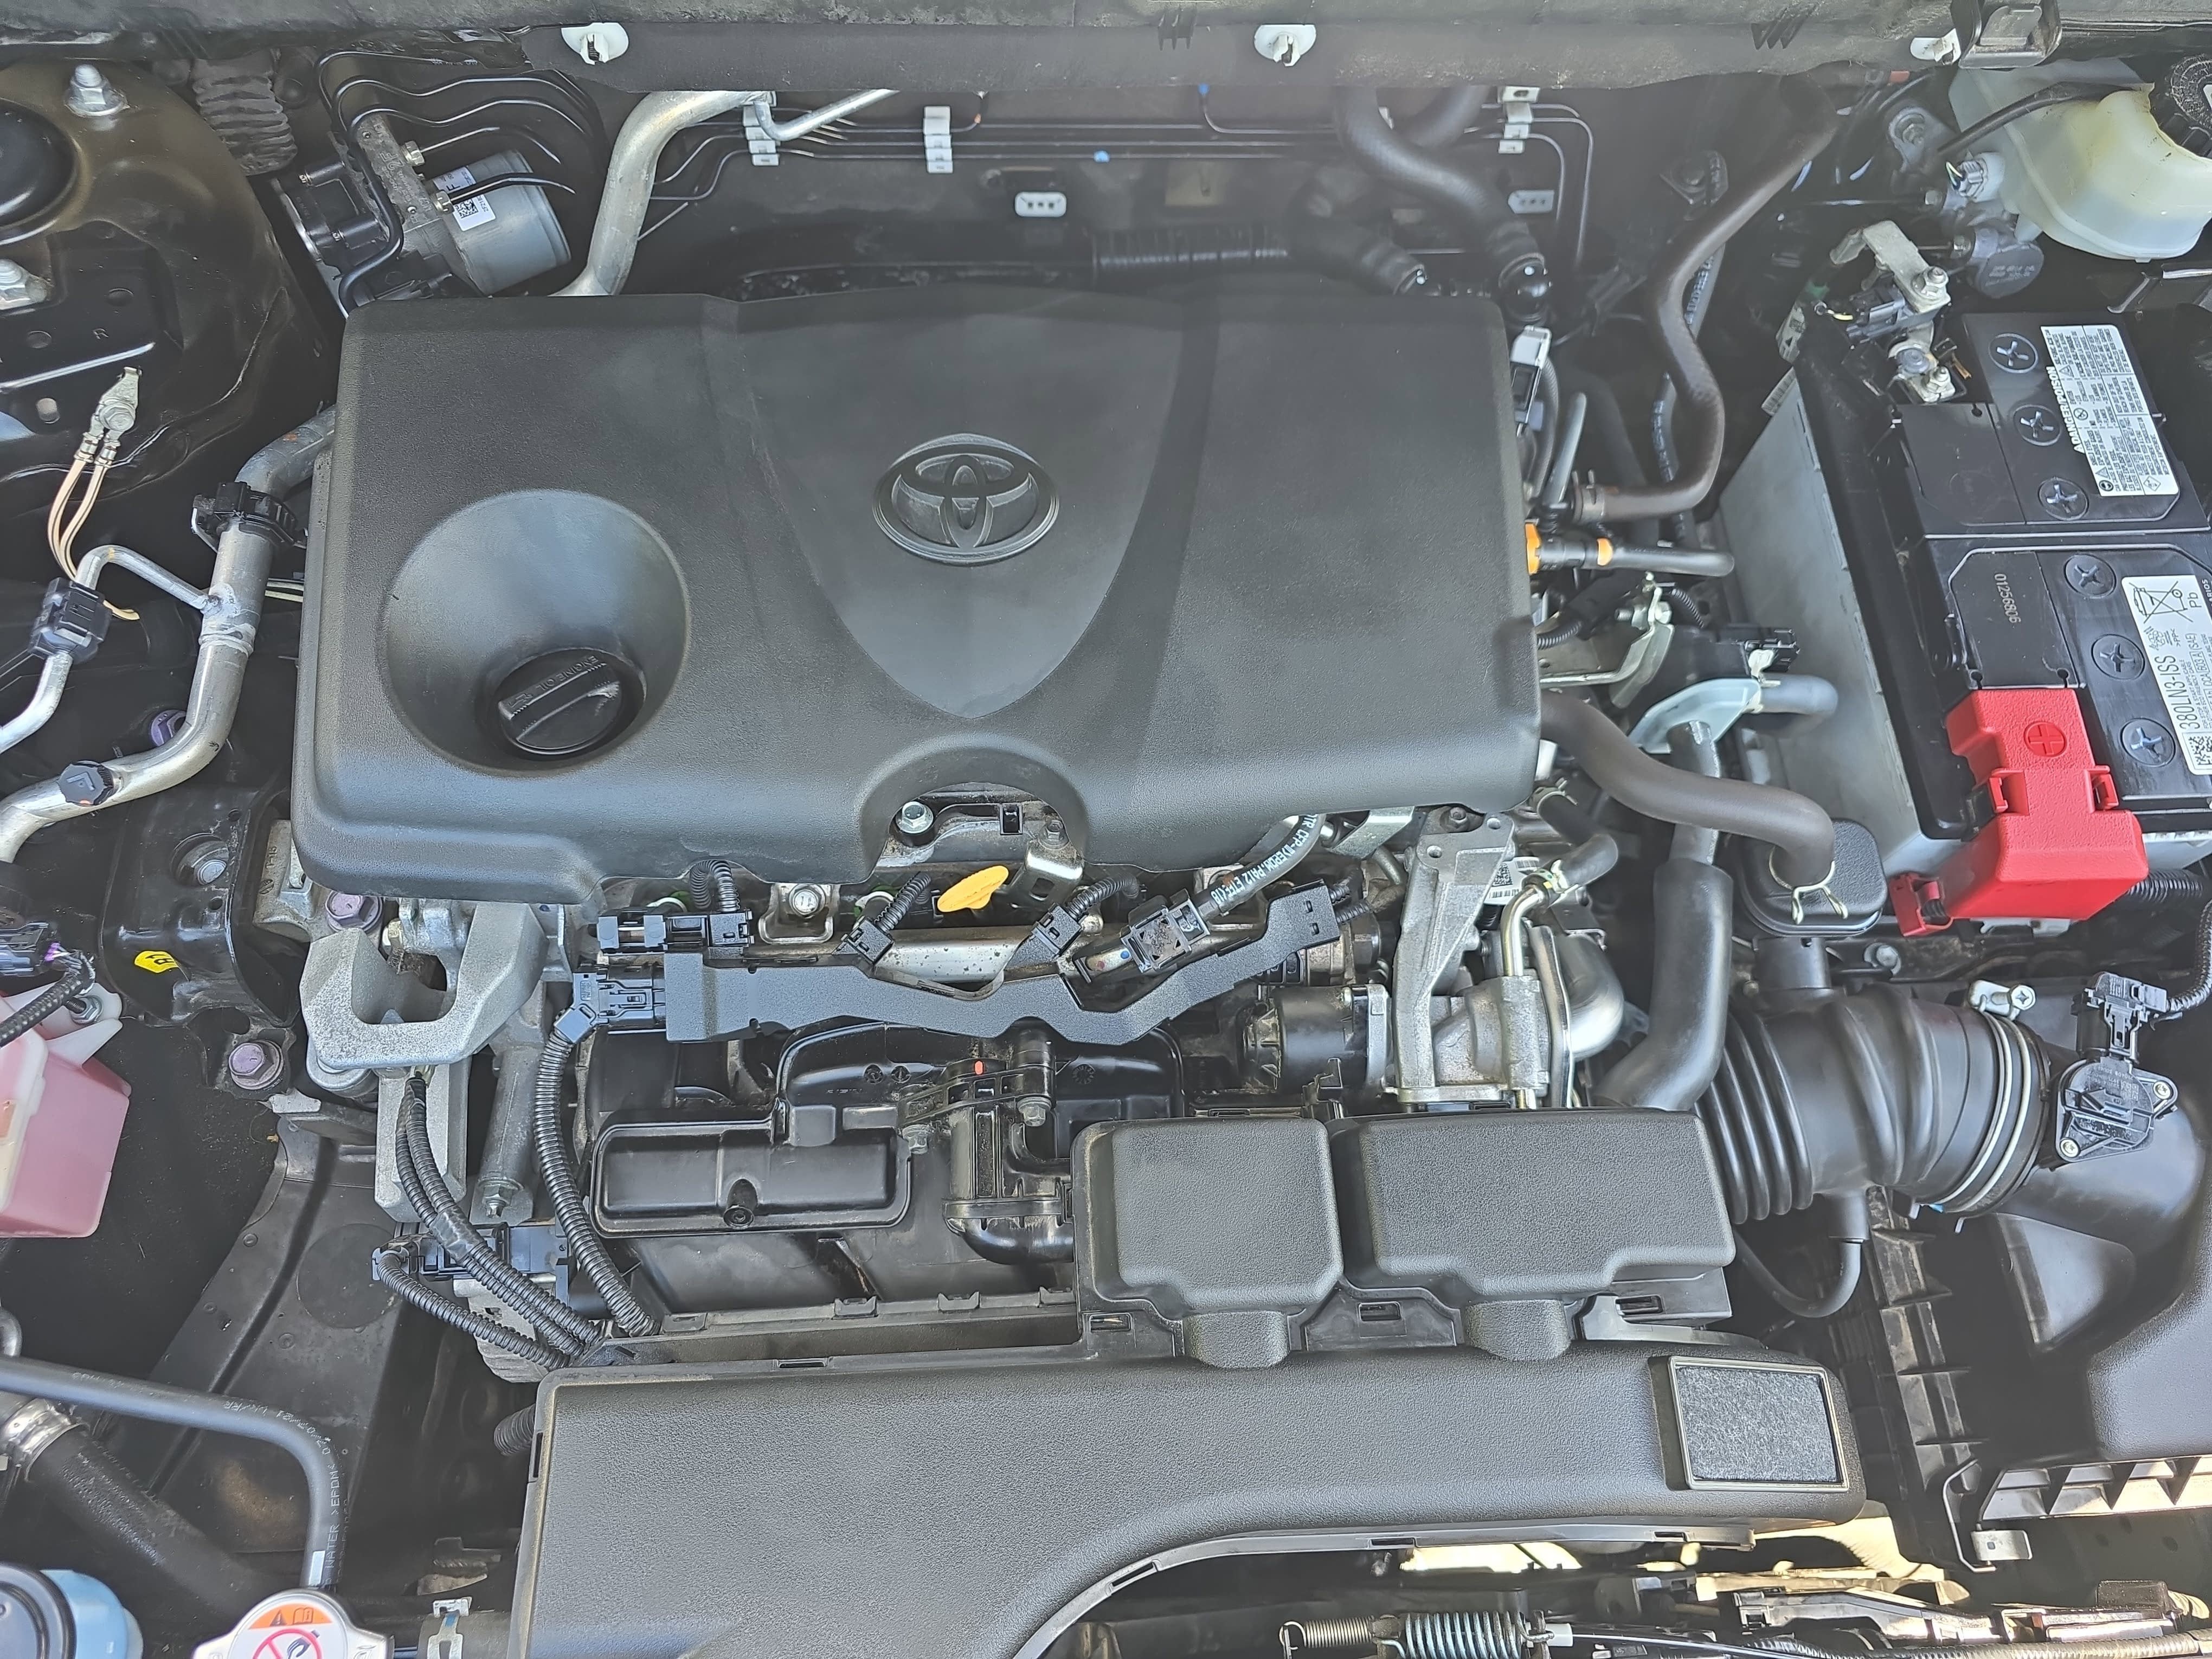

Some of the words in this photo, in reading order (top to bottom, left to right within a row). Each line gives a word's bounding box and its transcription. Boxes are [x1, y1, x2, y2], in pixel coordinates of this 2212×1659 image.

[2045, 365, 2084, 442] DANGER/POISON
[1993, 574, 2021, 623] 01256806
[2188, 592, 2202, 608] Pb
[536, 678, 557, 691] OIL
[556, 655, 599, 682] ENGINE
[2154, 655, 2200, 729] 380LN3-ISS
[325, 1523, 339, 1569] WATER
